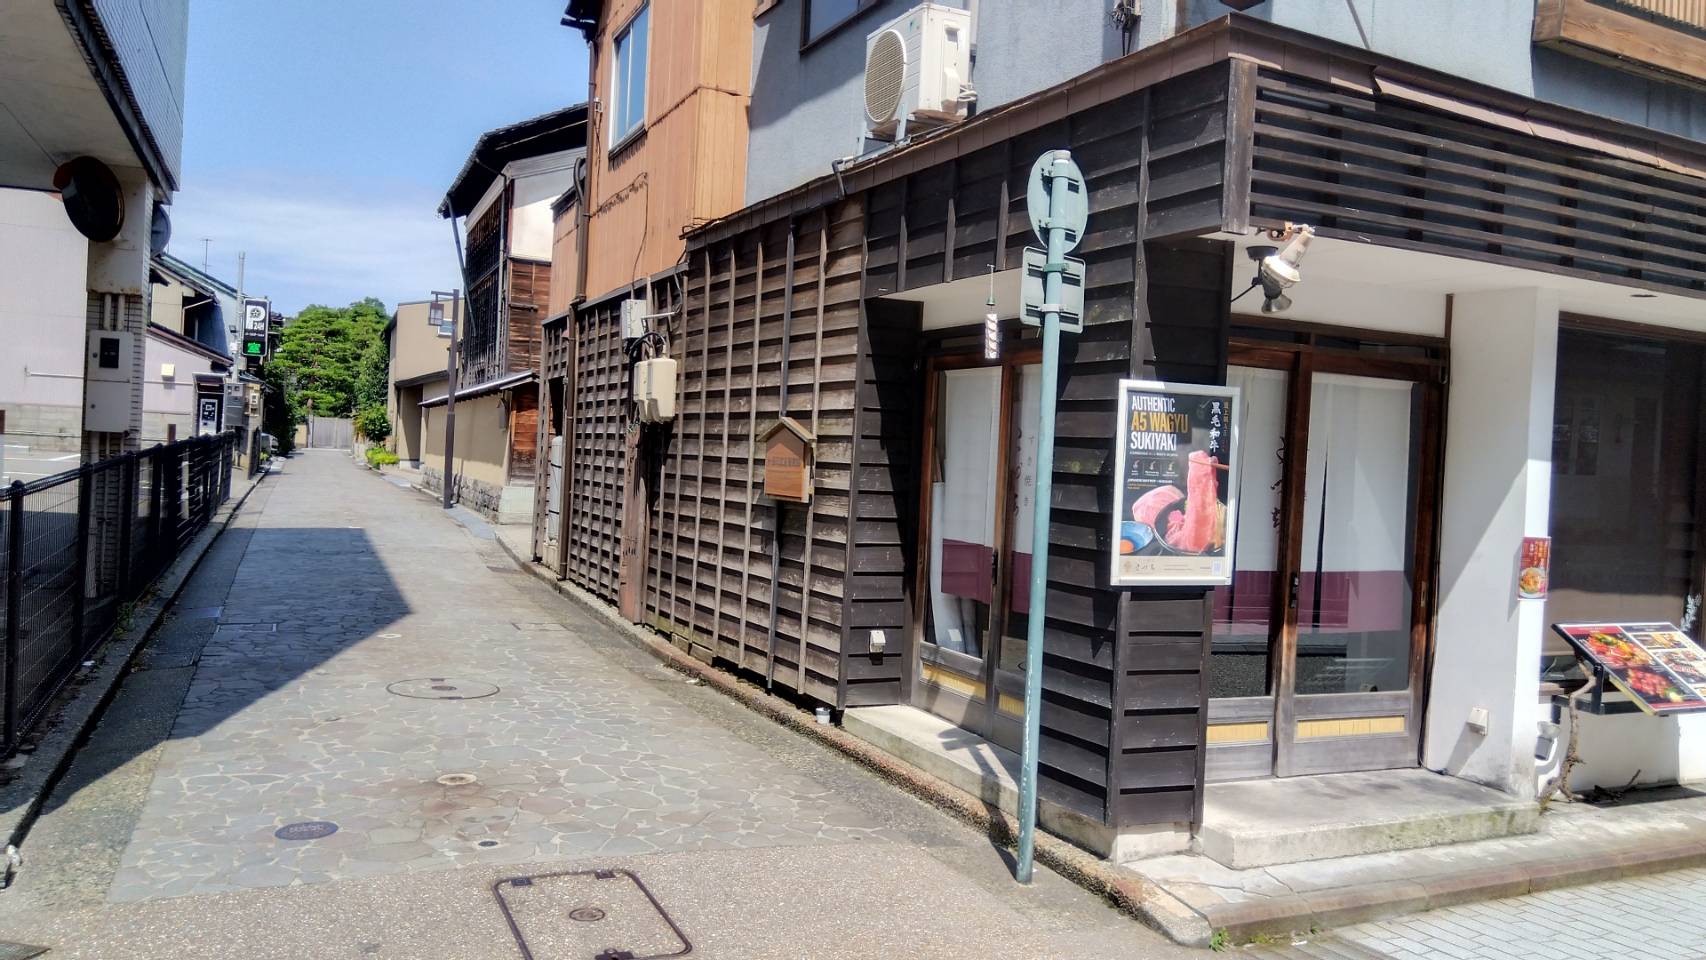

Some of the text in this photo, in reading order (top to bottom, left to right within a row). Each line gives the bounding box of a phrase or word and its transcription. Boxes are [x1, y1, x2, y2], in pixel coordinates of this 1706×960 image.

[1131, 395, 1176, 412] AUTHENTIC
[1131, 410, 1188, 433] A5 WAGYU
[1209, 401, 1221, 453] 黒毛和牛
[1130, 431, 1177, 451] SUKIYAKI
